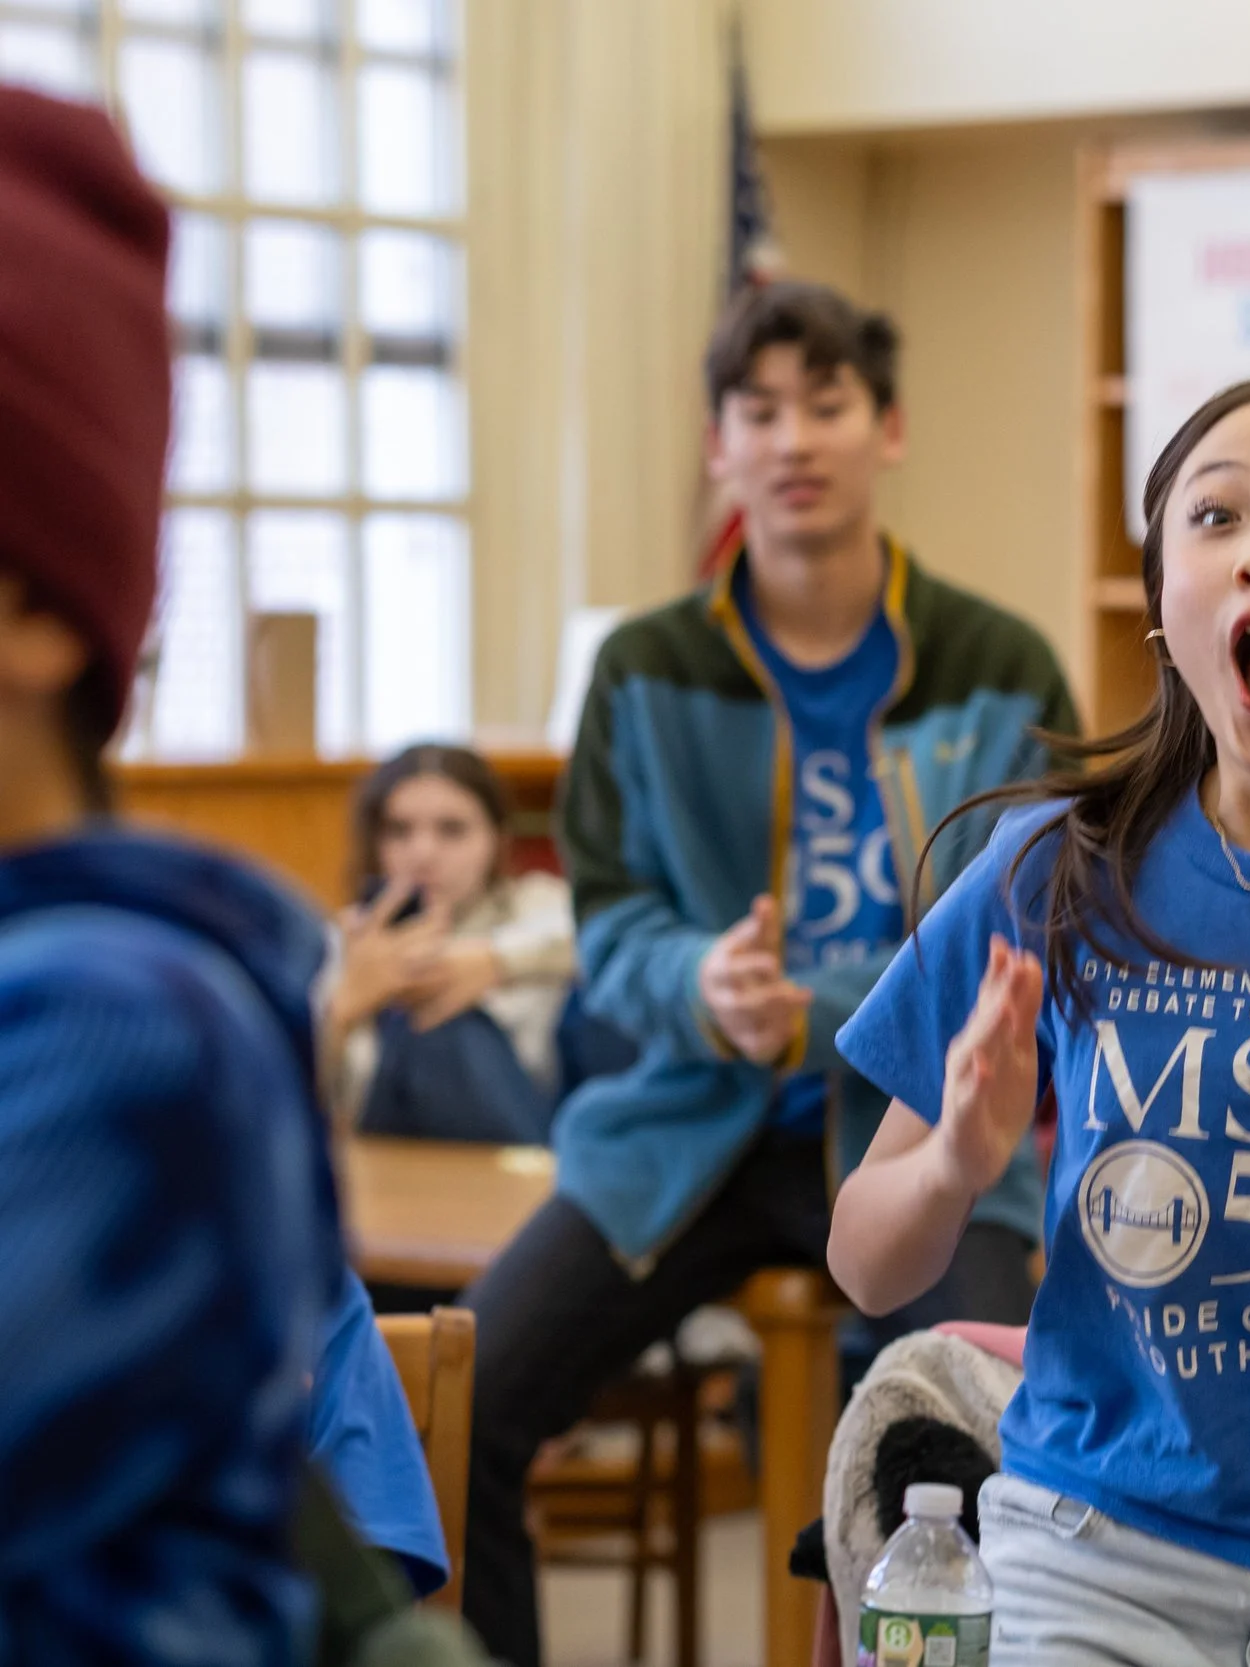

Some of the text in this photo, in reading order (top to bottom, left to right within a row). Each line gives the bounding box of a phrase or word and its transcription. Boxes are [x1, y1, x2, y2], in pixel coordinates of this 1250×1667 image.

[801, 749, 856, 833] S
[1083, 959, 1130, 982] D14
[1108, 987, 1216, 1019] DEBATE
